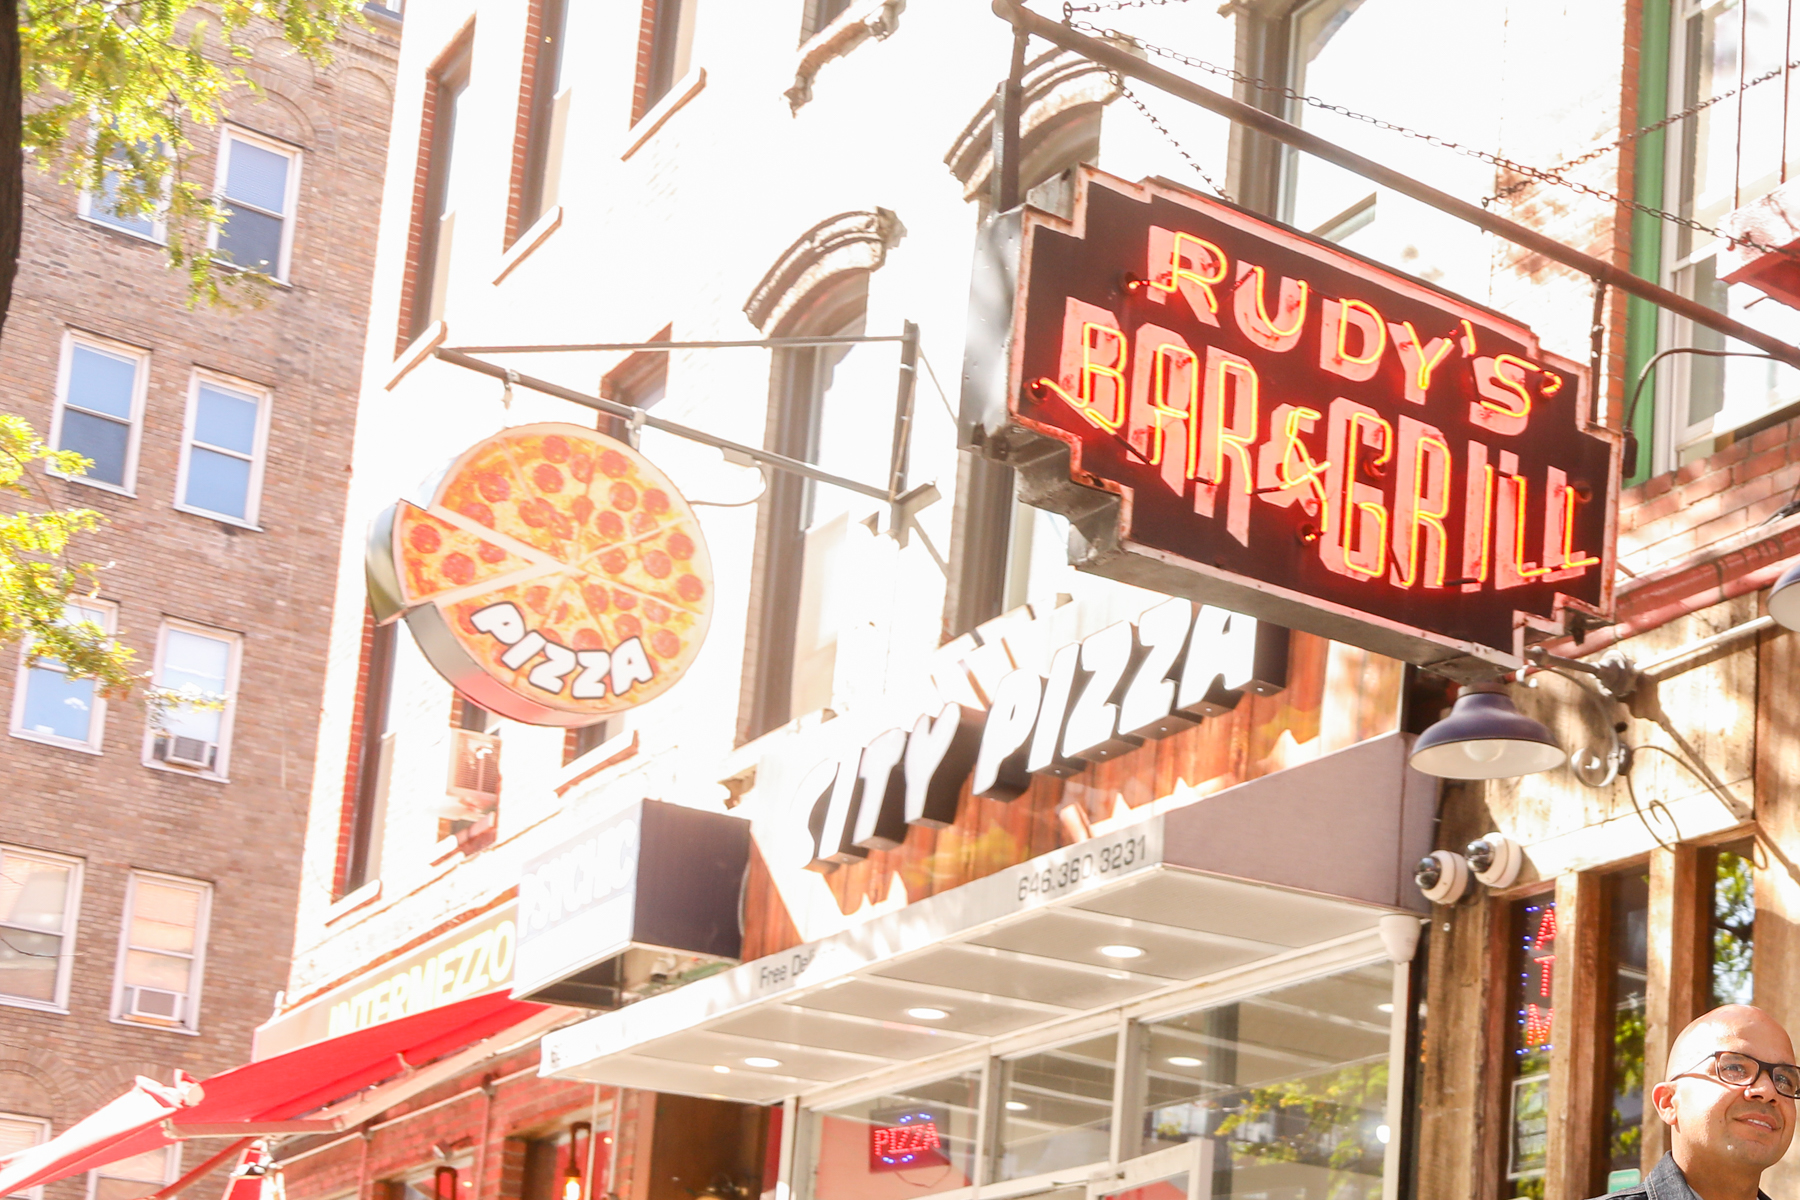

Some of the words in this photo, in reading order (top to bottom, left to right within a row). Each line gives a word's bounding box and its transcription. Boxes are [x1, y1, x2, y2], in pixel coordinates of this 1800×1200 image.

[1147, 224, 1561, 436] RUDY'S
[470, 600, 654, 699] PIZZA
[973, 596, 1257, 795] PIZZA
[1017, 834, 1147, 902] 646.360.3231
[327, 918, 517, 1038] INTERMEZZO
[760, 963, 788, 990] Free
[874, 1122, 941, 1157] PIZZA
